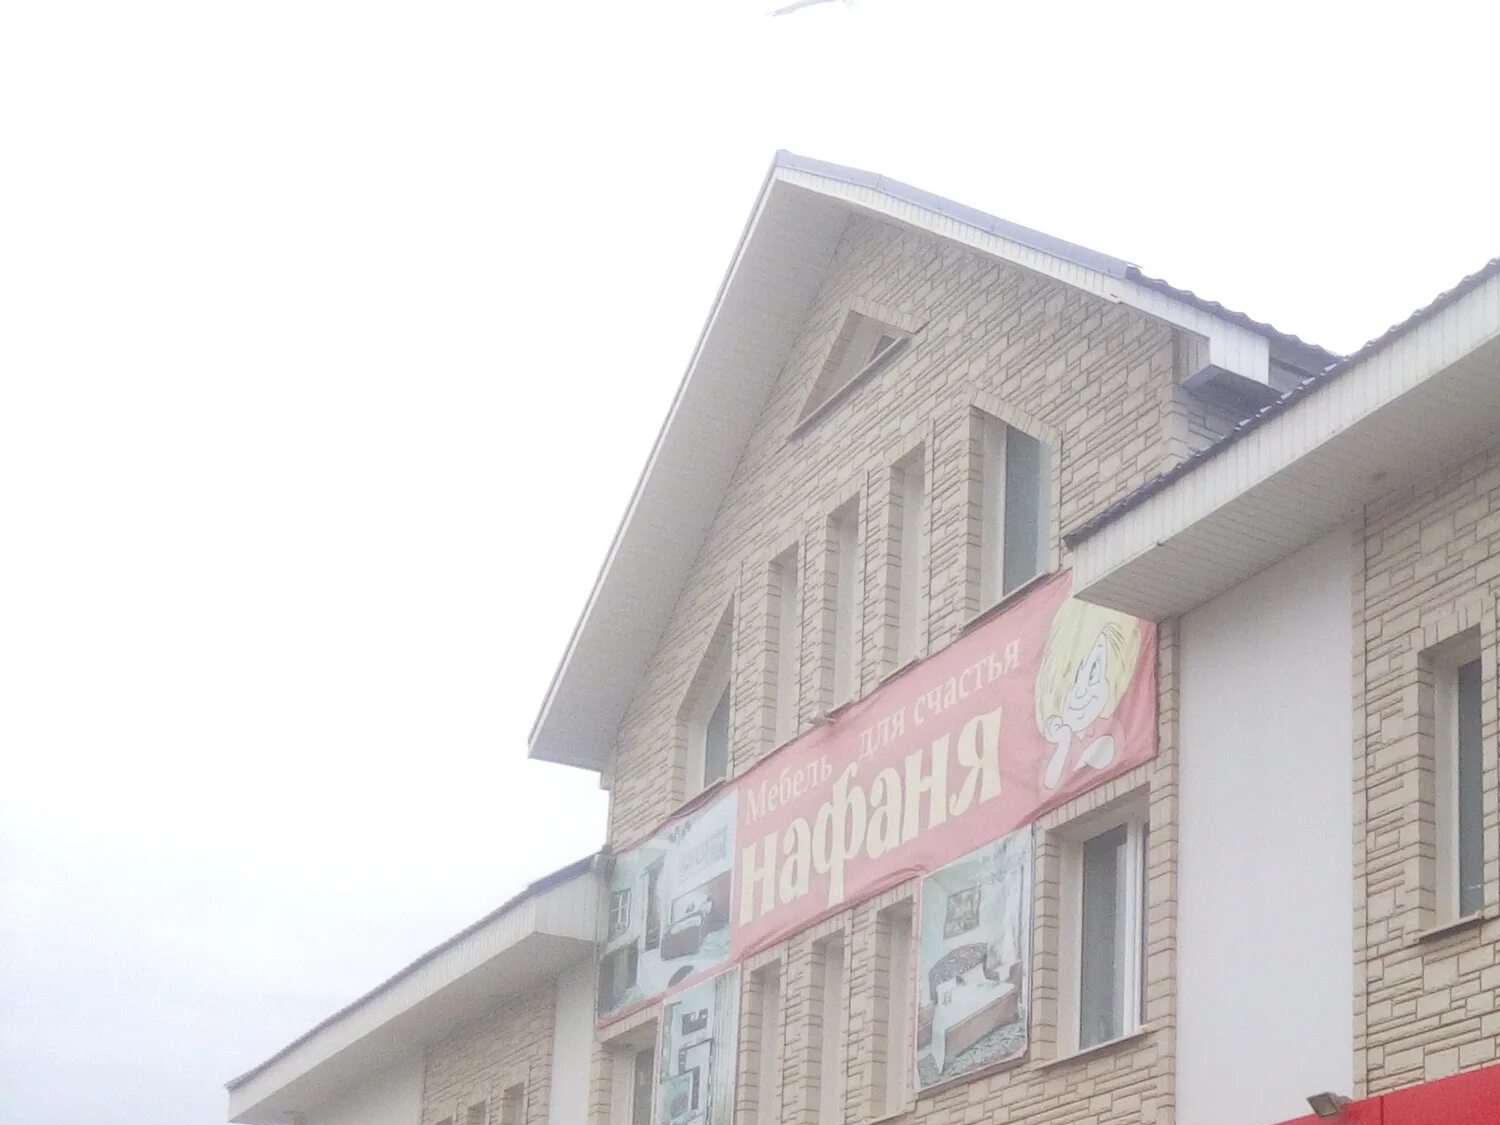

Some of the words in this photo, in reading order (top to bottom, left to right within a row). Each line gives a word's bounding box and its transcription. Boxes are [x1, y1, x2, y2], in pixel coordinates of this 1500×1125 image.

[747, 755, 832, 822] Мебель
[859, 707, 905, 760] для
[914, 638, 1021, 725] счастья
